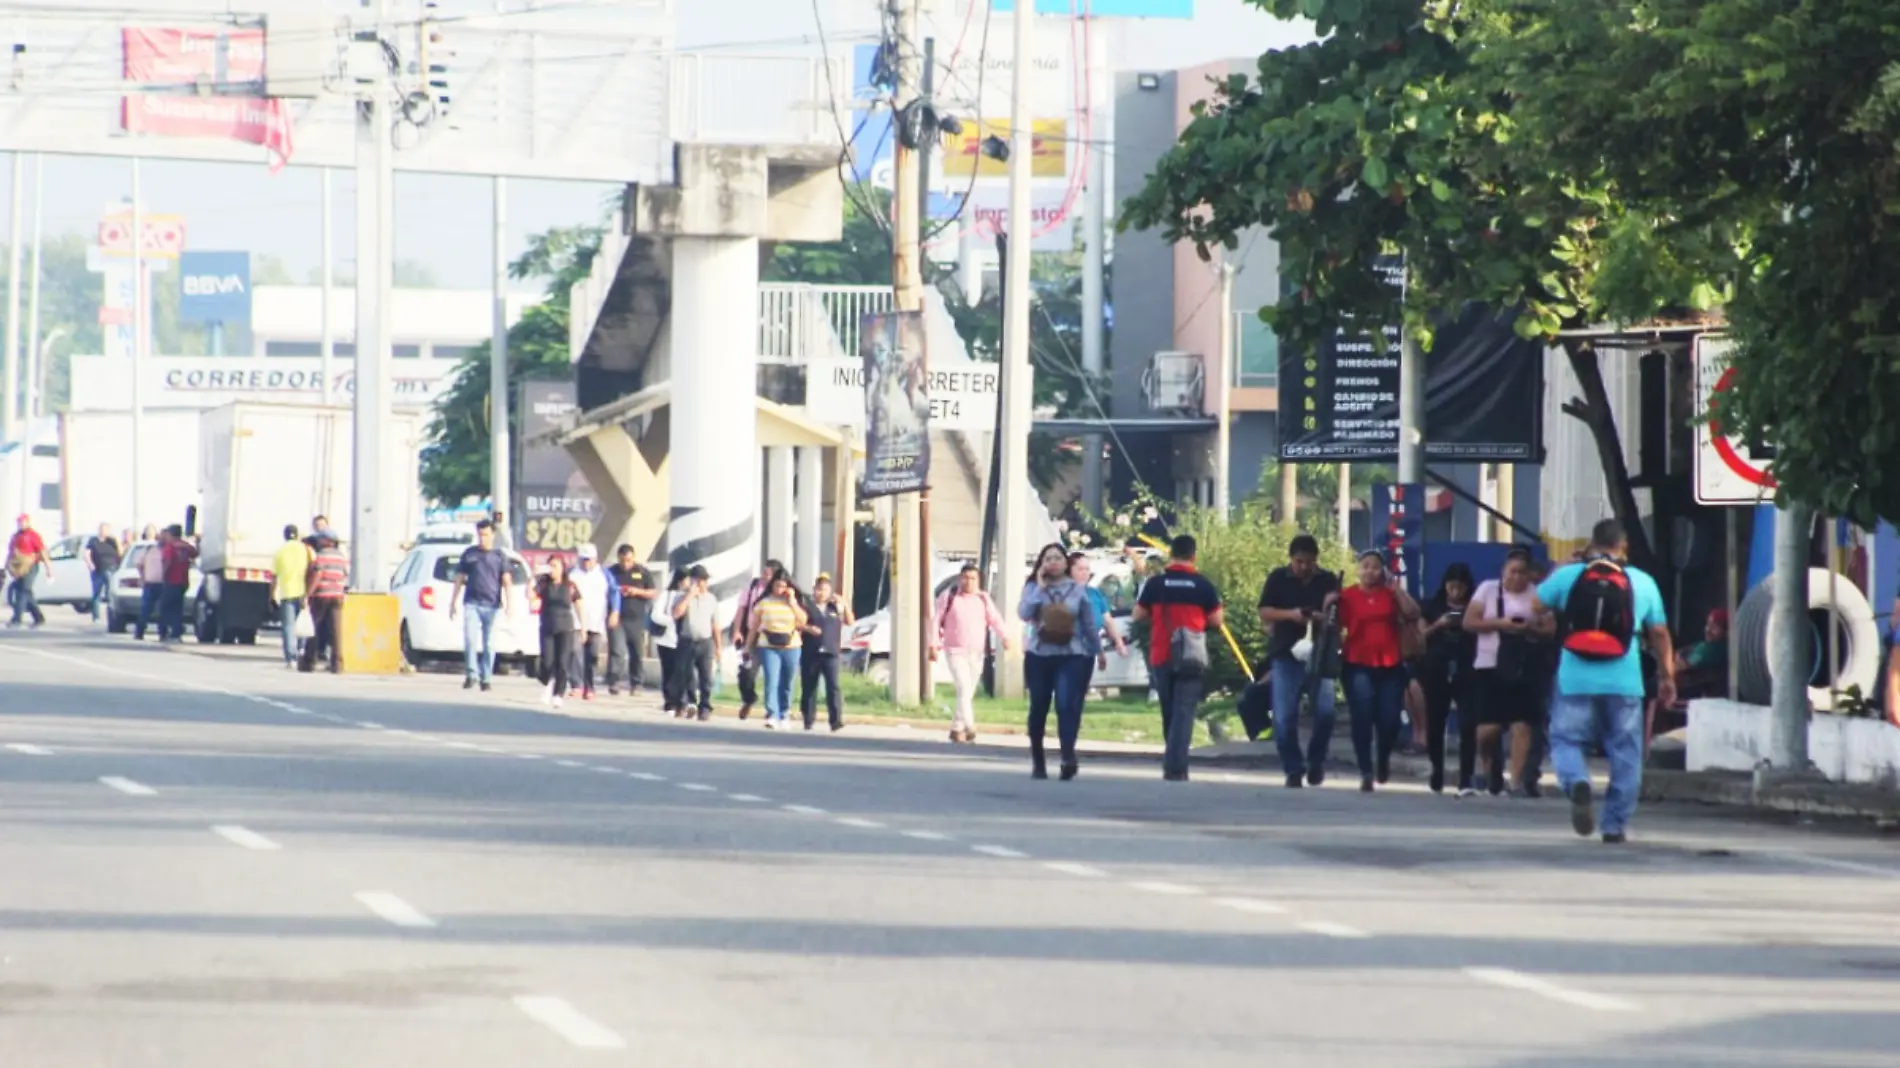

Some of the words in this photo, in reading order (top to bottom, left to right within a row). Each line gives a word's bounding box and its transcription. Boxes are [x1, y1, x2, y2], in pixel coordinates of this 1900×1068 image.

[183, 274, 244, 295] BBVA
[1337, 358, 1398, 368] DIRECCIÓN
[1336, 376, 1380, 386] FRENOS
[1334, 392, 1377, 401] CAMBIO
[1333, 402, 1374, 411] ACEITE
[526, 496, 593, 513] BUFFET
[525, 518, 592, 551] $269
